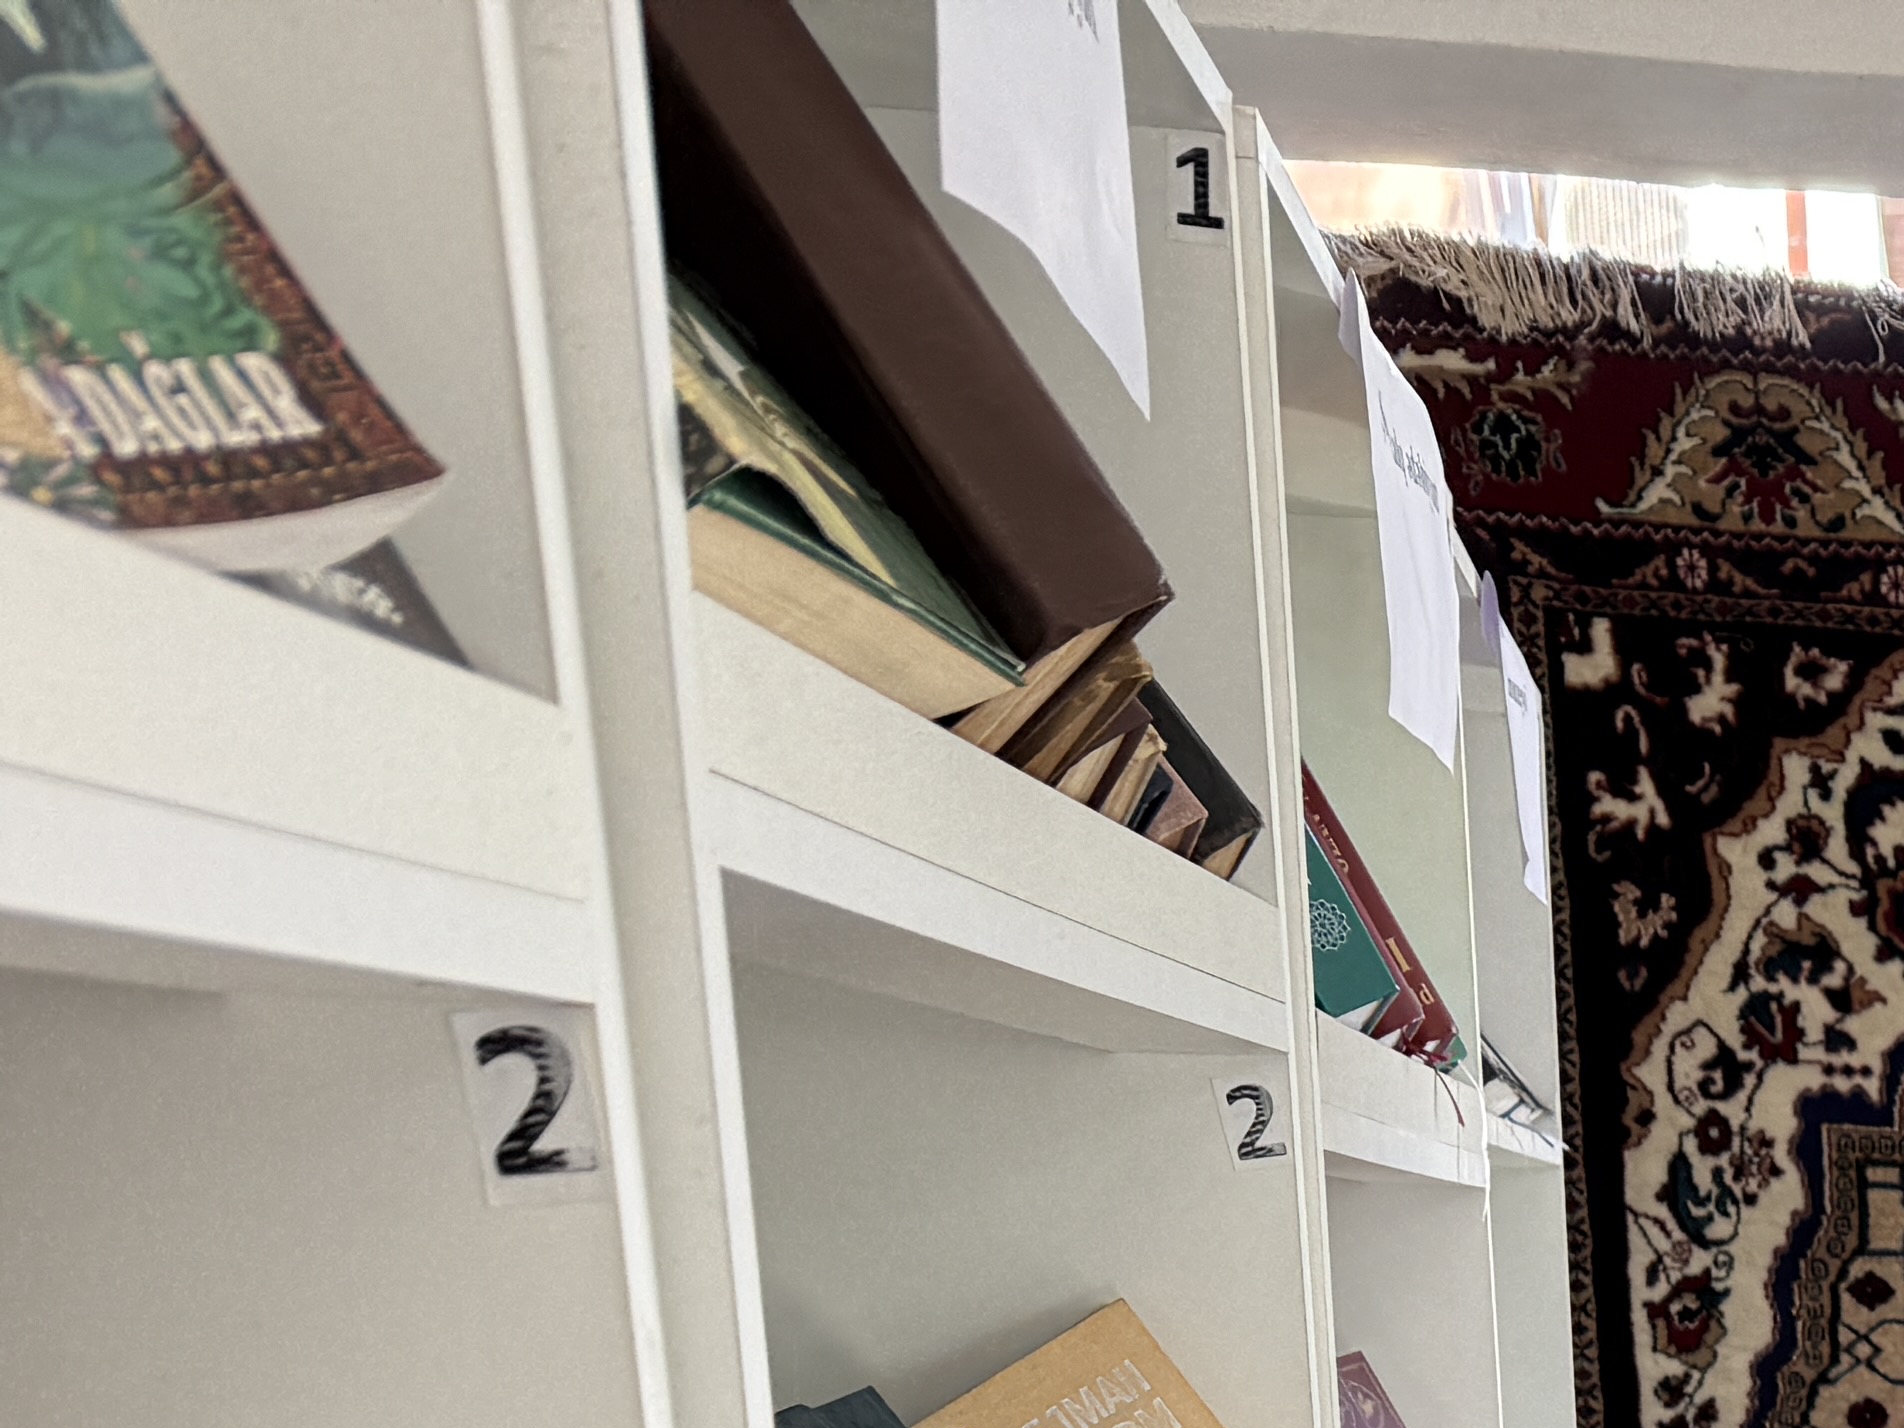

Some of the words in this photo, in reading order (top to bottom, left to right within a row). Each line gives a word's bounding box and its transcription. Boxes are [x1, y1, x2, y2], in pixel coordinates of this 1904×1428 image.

[1177, 148, 1225, 229] 1
[475, 1025, 598, 1176] 2
[1226, 1084, 1287, 1160] 2
